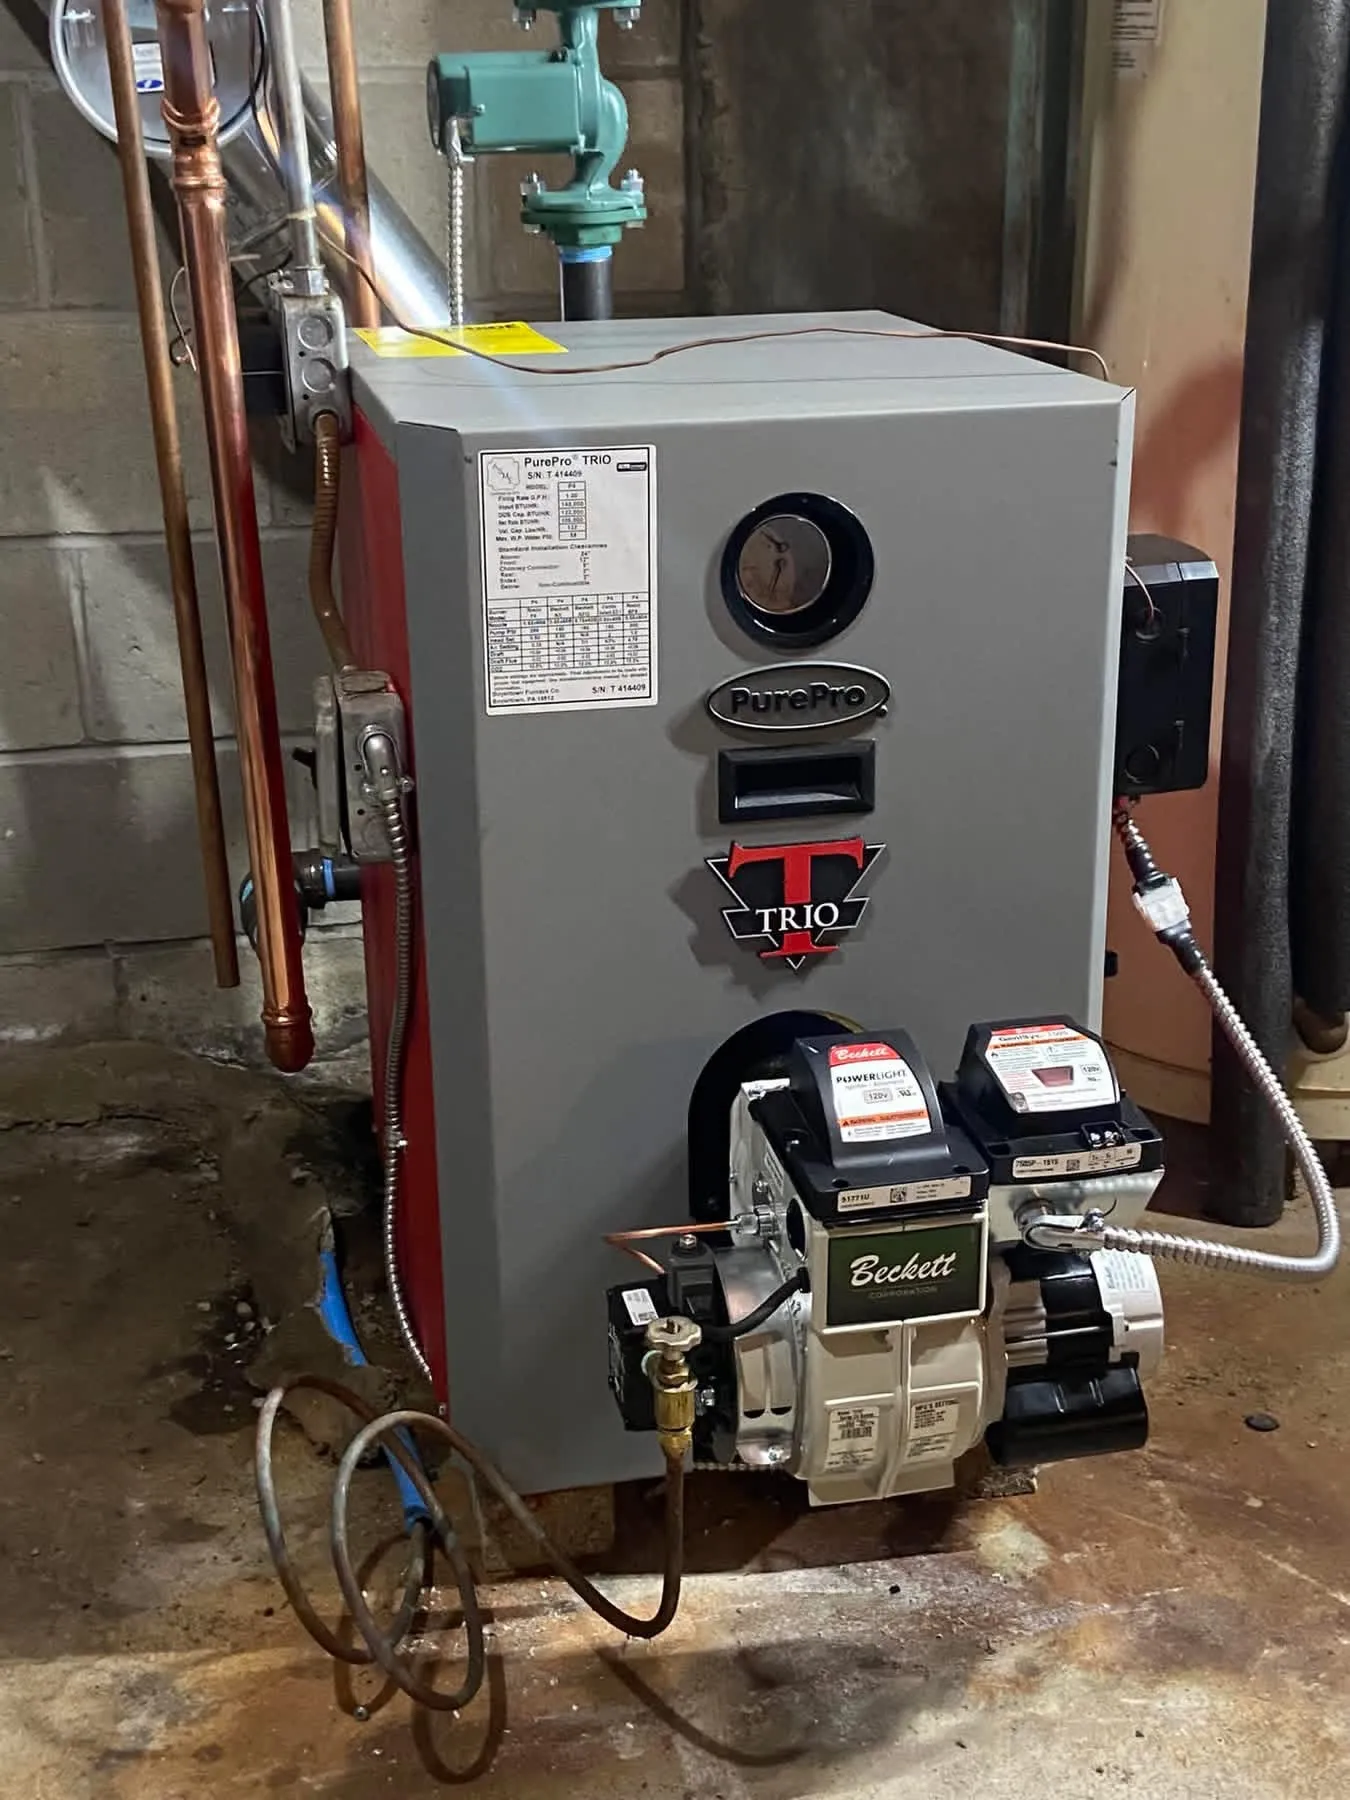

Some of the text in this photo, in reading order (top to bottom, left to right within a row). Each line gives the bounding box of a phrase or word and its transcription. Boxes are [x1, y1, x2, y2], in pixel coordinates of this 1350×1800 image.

[582, 454, 612, 466] TRIO
[547, 471, 553, 479] T
[555, 469, 583, 478] 414409
[498, 542, 608, 553] Standard Installation Clearances
[610, 684, 617, 693] T
[617, 683, 647, 692] 414409
[730, 682, 867, 714] PurePro
[755, 902, 840, 934] TRIO
[835, 1047, 892, 1061] Beckett
[836, 1069, 907, 1084] POWERLIGHT
[850, 1252, 956, 1287] Beckett
